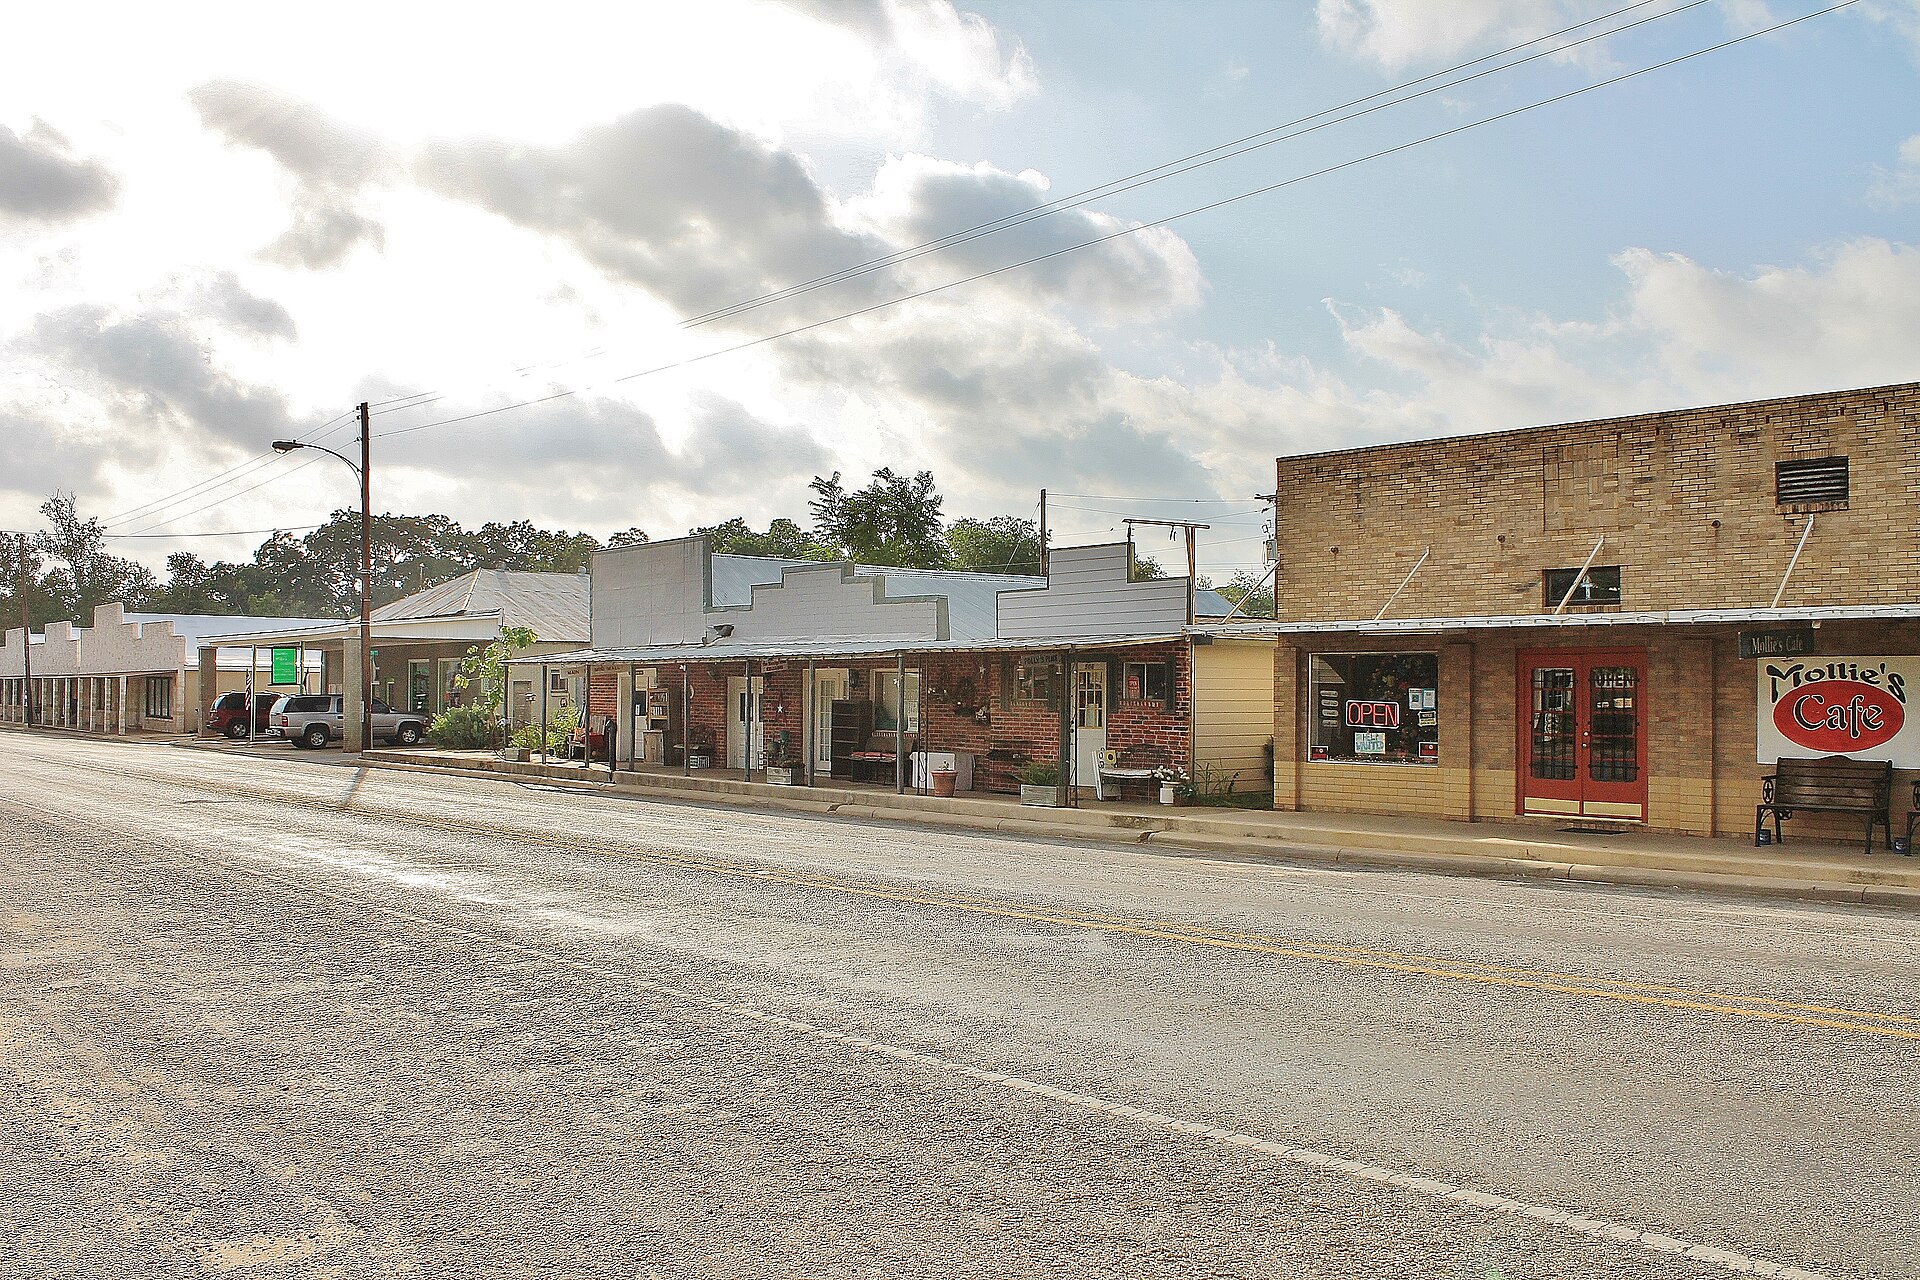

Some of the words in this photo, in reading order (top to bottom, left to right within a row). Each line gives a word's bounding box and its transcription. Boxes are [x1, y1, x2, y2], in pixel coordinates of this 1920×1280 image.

[1752, 635, 1783, 654] Mollie's
[1786, 634, 1803, 651] Cafe
[1595, 672, 1634, 688] OPEN
[1766, 662, 1907, 704] Mollie's
[1348, 703, 1398, 726] OPEN
[1793, 695, 1885, 739] Cafe
[1362, 733, 1379, 741] HELP
